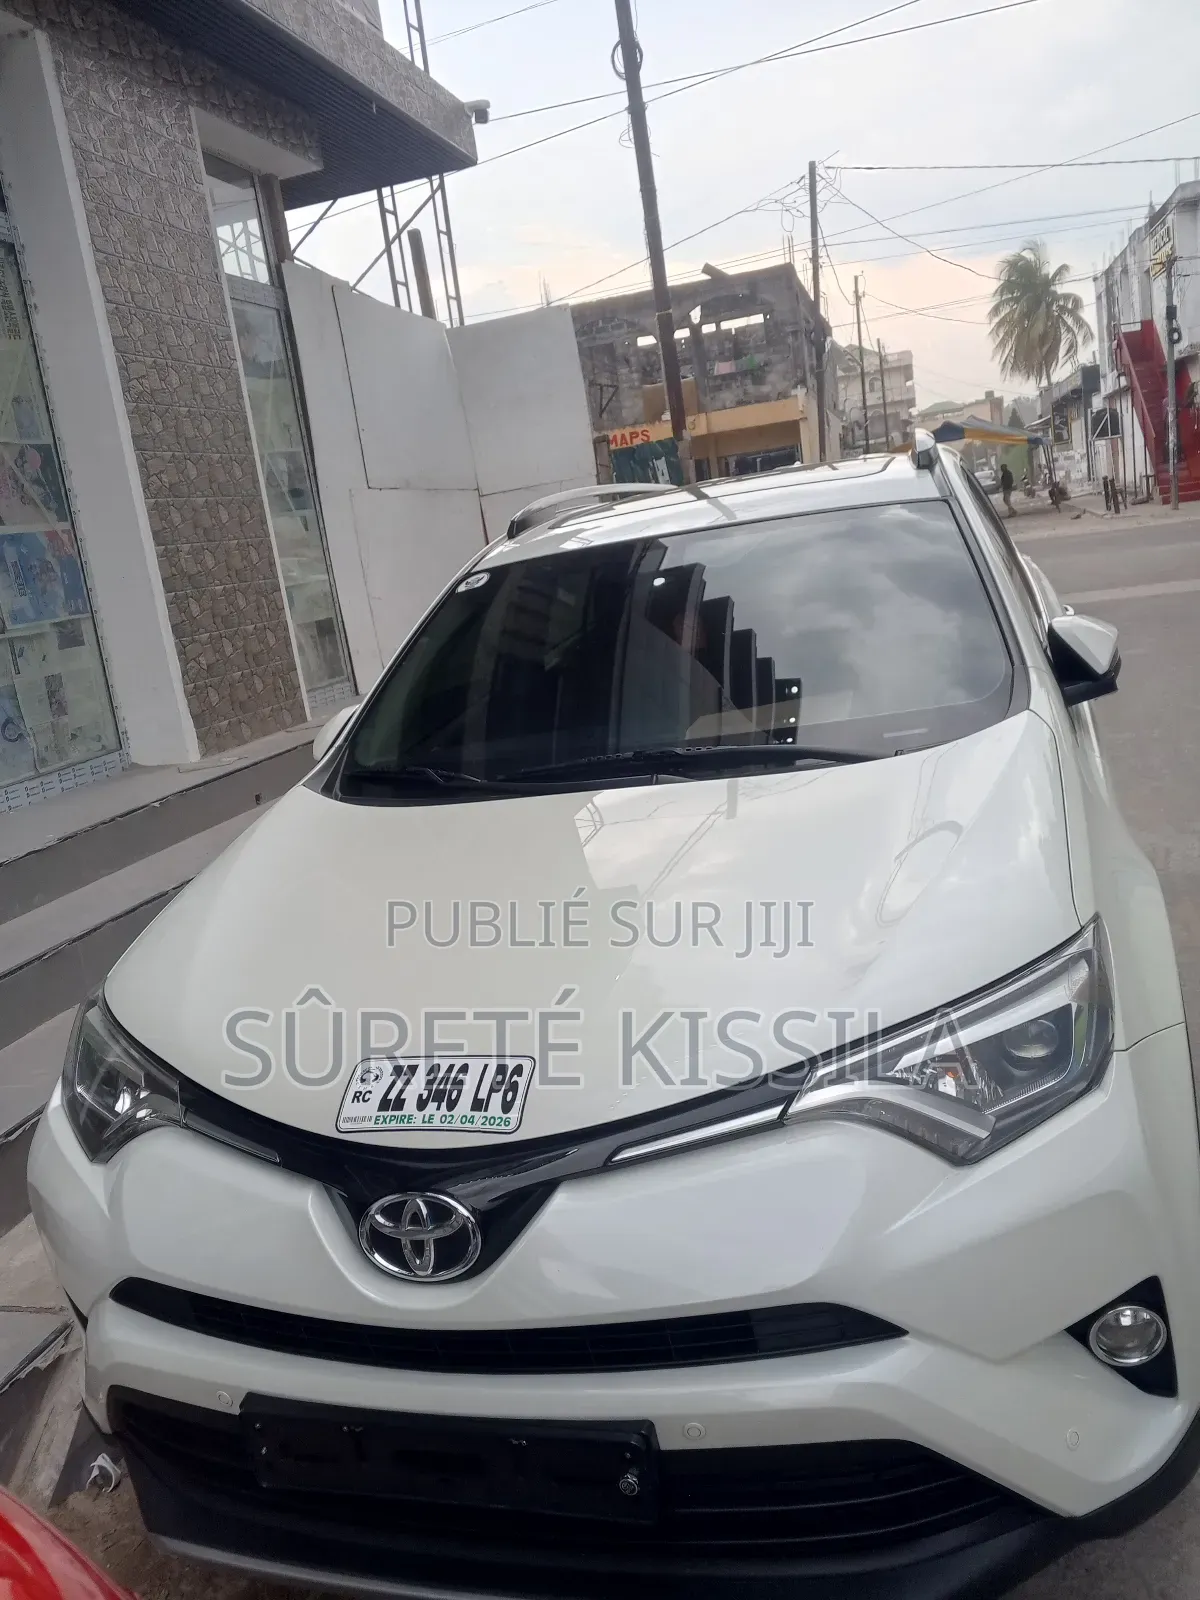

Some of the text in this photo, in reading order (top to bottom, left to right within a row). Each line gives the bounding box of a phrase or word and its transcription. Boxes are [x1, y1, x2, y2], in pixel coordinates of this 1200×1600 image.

[376, 1063, 420, 1112] ZZ
[416, 1062, 470, 1112] 346
[469, 1063, 524, 1115] LP6
[351, 1090, 373, 1104] RC
[373, 1114, 417, 1126] EXPIRE:
[421, 1114, 435, 1124] LE
[439, 1114, 511, 1127] 02/04/2026
